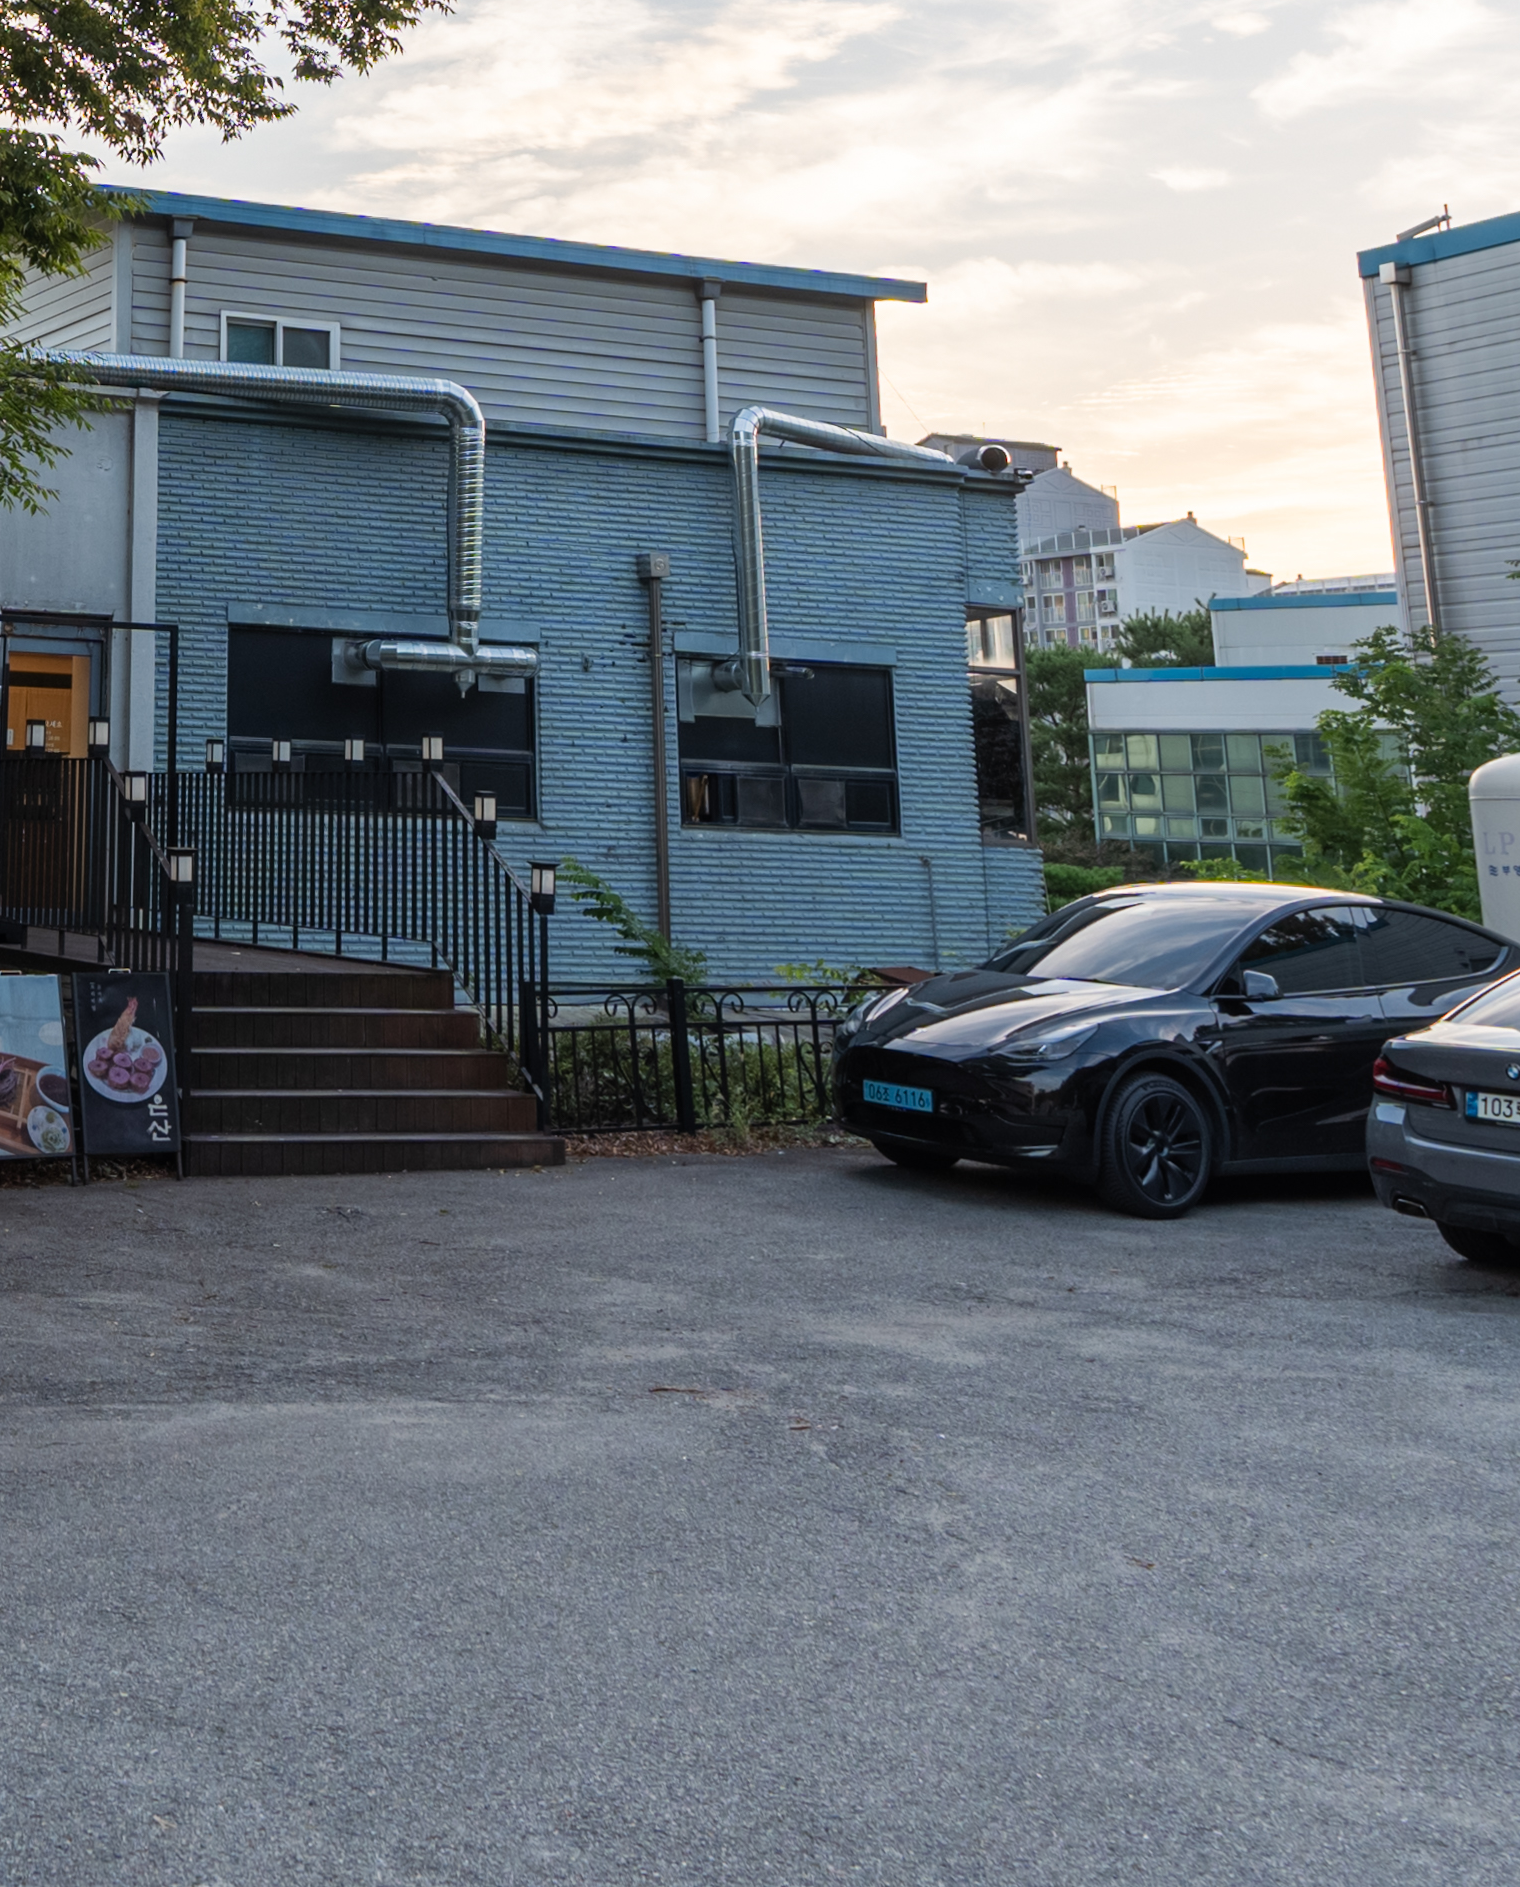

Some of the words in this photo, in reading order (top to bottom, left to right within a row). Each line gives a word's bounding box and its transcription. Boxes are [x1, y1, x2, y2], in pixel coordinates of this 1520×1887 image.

[868, 1083, 890, 1102] 06조
[895, 1088, 926, 1108] 6116
[146, 1094, 173, 1142] 은산
